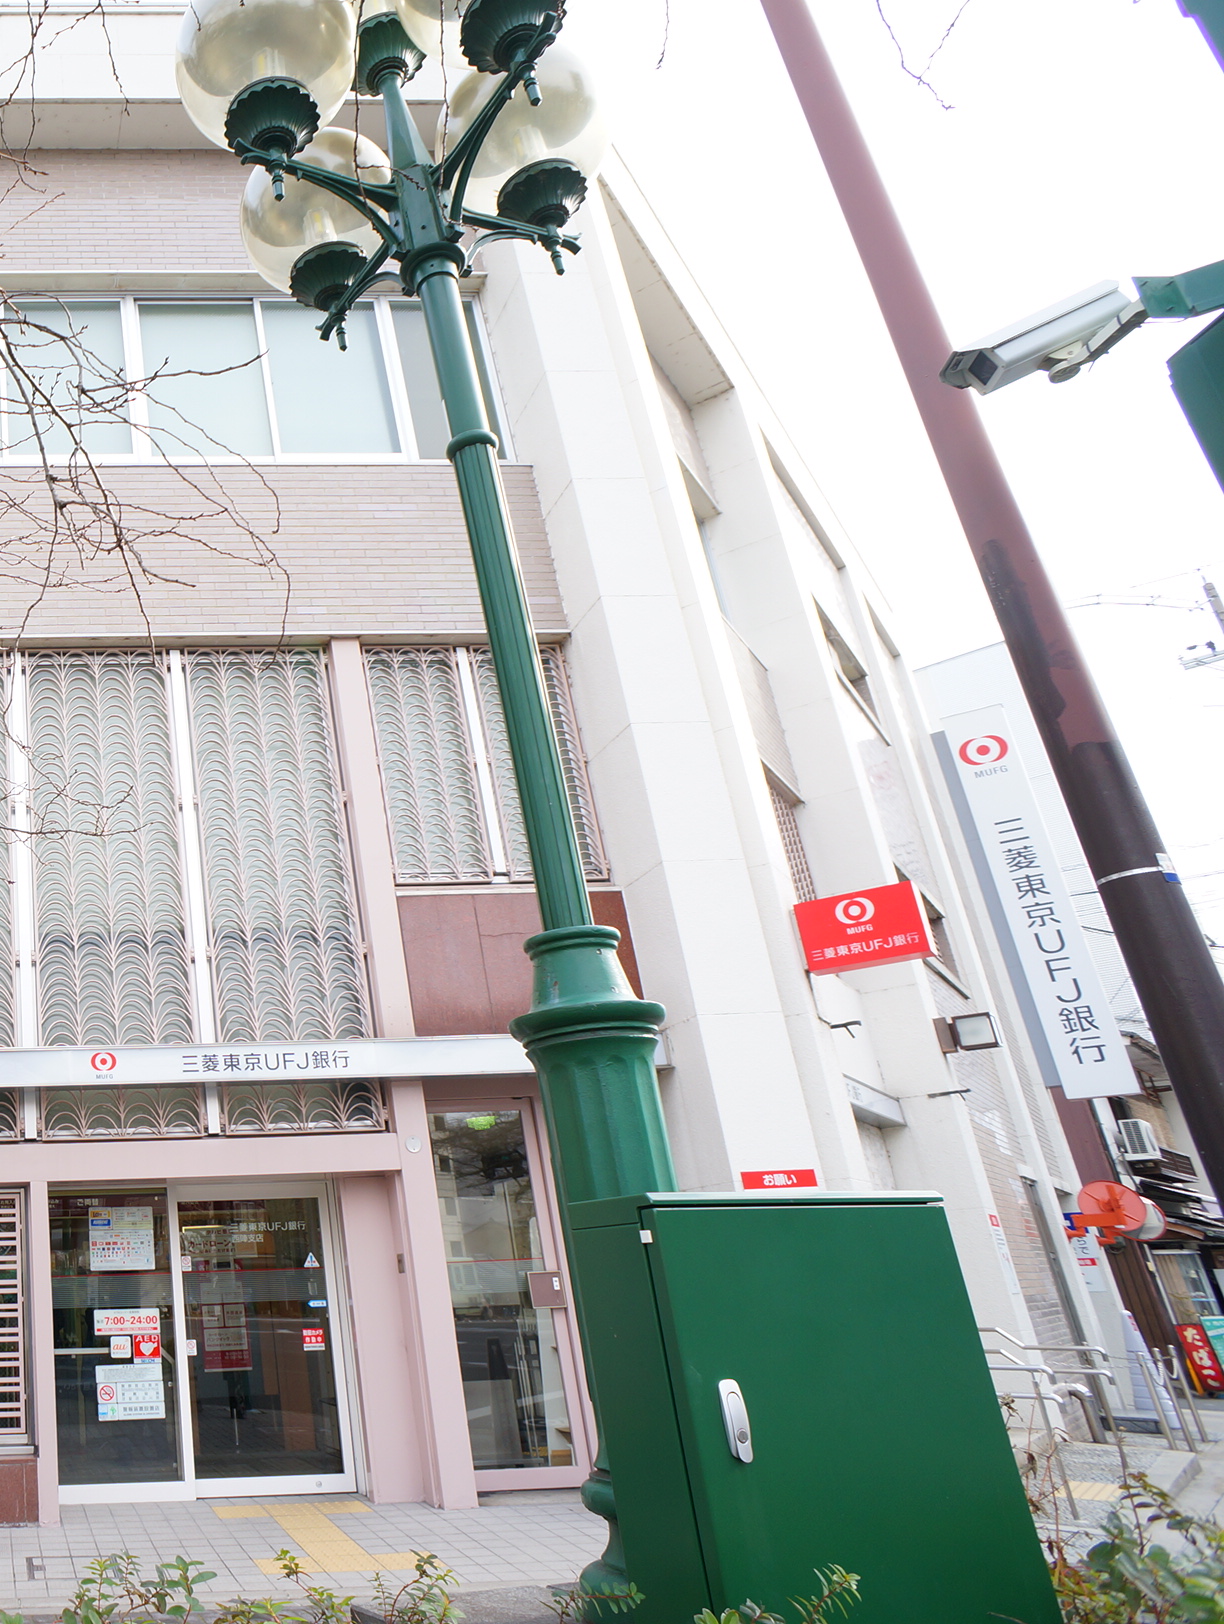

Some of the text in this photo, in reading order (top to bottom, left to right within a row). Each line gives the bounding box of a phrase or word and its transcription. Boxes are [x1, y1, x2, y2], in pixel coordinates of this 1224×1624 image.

[974, 765, 1009, 778] MUFG
[846, 924, 873, 935] MUFG
[994, 817, 1106, 1065] 三菱東京UFJ銀行
[811, 932, 919, 961] 三菱東京UFJ銀行
[182, 1050, 350, 1073] 三菱東京UFJ銀行
[762, 1173, 797, 1186] お願い
[1183, 1327, 1220, 1387] たばこ
